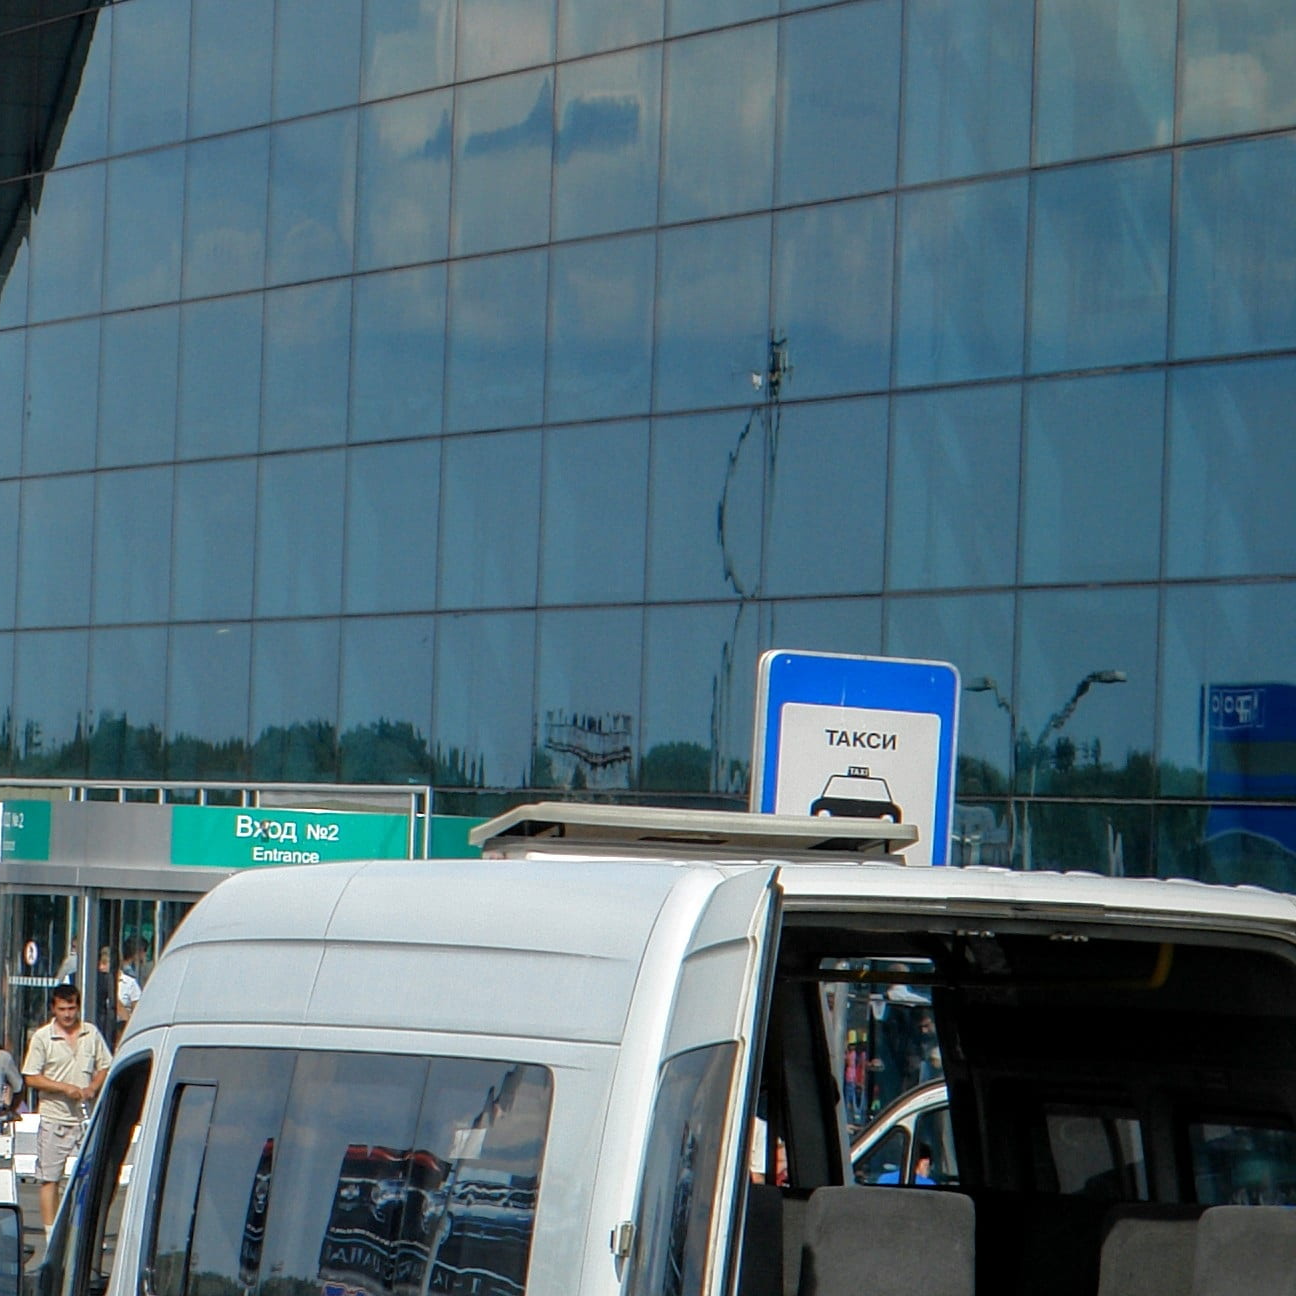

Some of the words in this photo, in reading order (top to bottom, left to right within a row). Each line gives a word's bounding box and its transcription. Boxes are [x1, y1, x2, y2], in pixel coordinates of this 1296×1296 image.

[825, 729, 897, 750] ТАКСИ
[850, 767, 869, 776] TAXI
[236, 814, 298, 843] Вход
[306, 823, 340, 841] №2
[253, 846, 320, 864] Entrance
